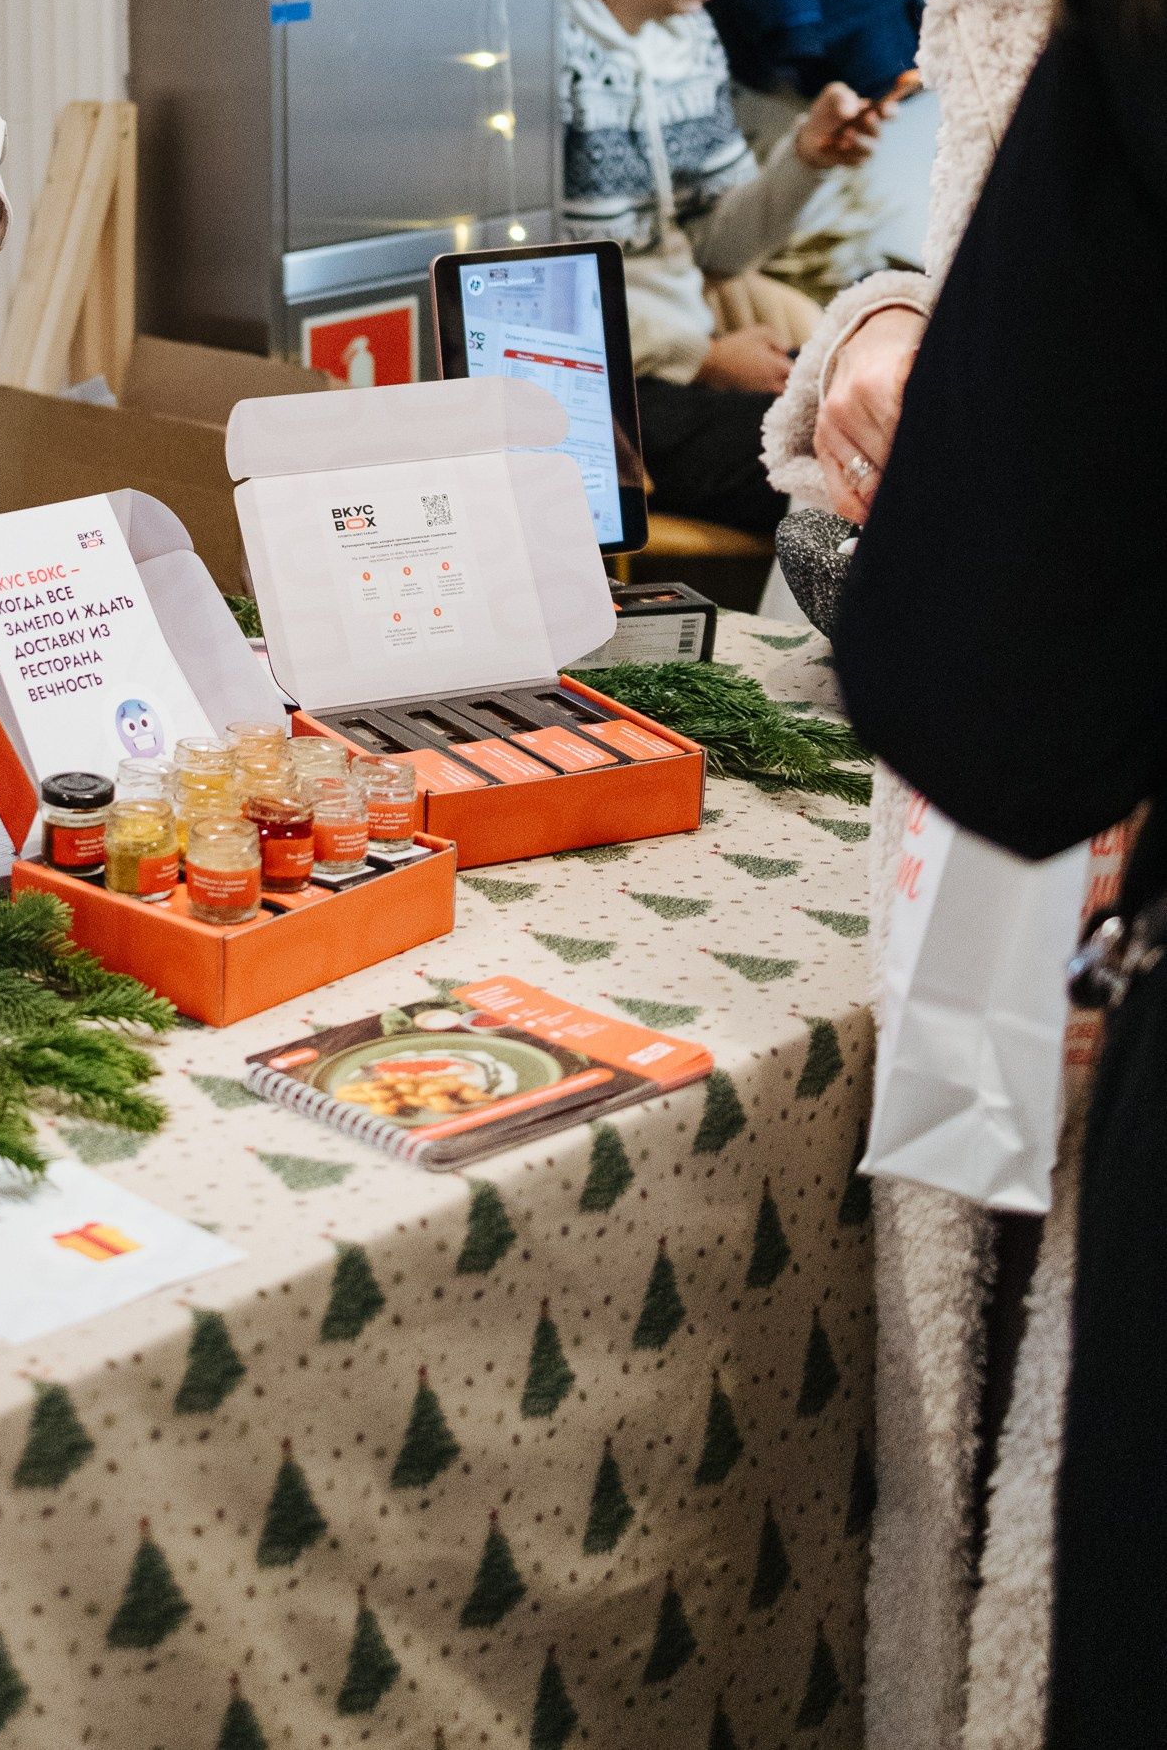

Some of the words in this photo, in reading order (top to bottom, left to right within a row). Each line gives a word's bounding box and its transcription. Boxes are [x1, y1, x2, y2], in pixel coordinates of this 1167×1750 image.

[331, 504, 375, 519] ВКУС
[334, 516, 377, 531] BOX
[77, 530, 102, 541] ВКУС
[80, 538, 105, 549] BOX
[27, 564, 67, 585] БОКС
[46, 585, 75, 604] ВСЕ
[4, 611, 64, 636] ЗАМЕЛО
[67, 608, 80, 621] И
[81, 595, 134, 619] ЖДАТЬ
[14, 628, 85, 660] ДОСТАВКУ
[89, 623, 111, 639] ИЗ
[19, 650, 103, 680] РЕСТОРАНА
[28, 672, 103, 702] ВЕЧНОСТЬ
